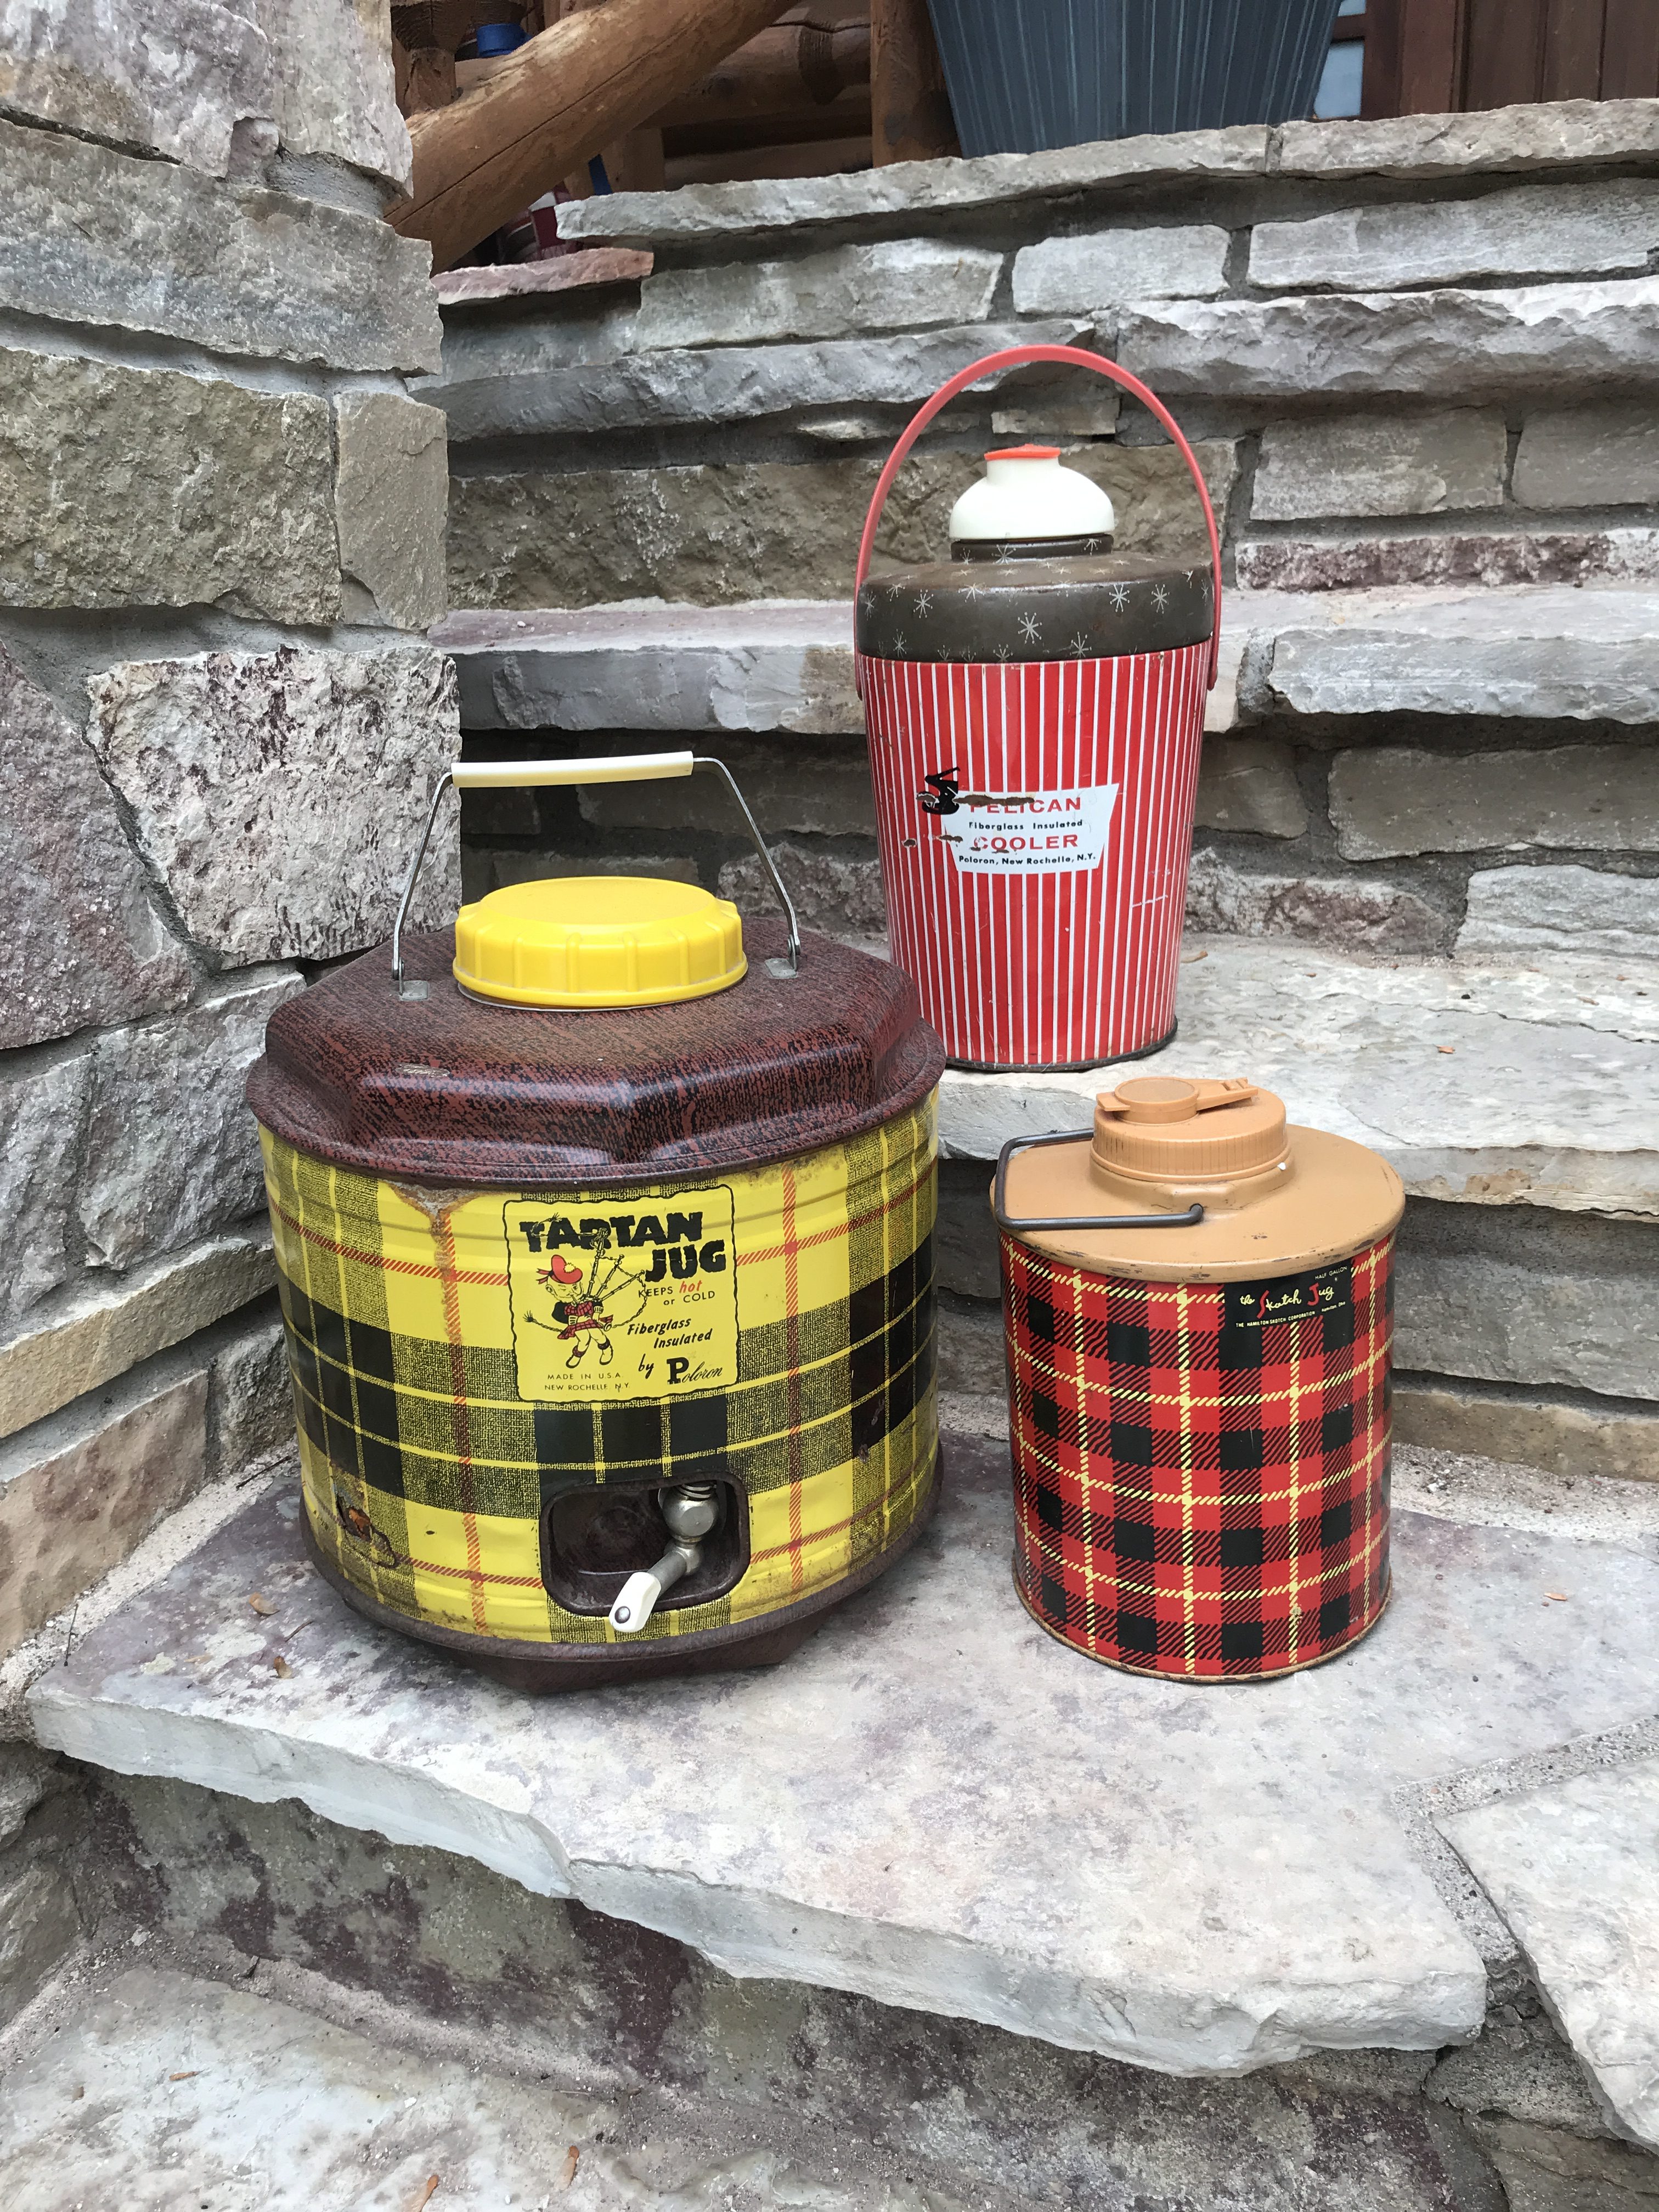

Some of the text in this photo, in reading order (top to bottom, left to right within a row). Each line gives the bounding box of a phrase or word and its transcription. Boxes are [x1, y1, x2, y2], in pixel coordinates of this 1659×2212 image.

[969, 820, 1083, 831] Fiberglass Insulated
[973, 834, 1079, 850] COOLER
[959, 856, 999, 865] Poloron,
[1027, 856, 1074, 865] Rochelle,
[1077, 853, 1096, 861] N.Y.
[519, 1211, 703, 1252] TARTAN
[645, 1239, 726, 1283] JUG
[1329, 1266, 1347, 1276] GALLON
[638, 1280, 702, 1298] KEEPS hot
[683, 1290, 715, 1303] COLD
[1240, 1294, 1255, 1305] the
[1307, 1282, 1334, 1306] Jug
[1288, 1311, 1315, 1321] CORPORATION
[627, 1318, 691, 1335] Fiberglass
[653, 1328, 713, 1348] Insulated
[638, 1353, 723, 1385] by Poloron
